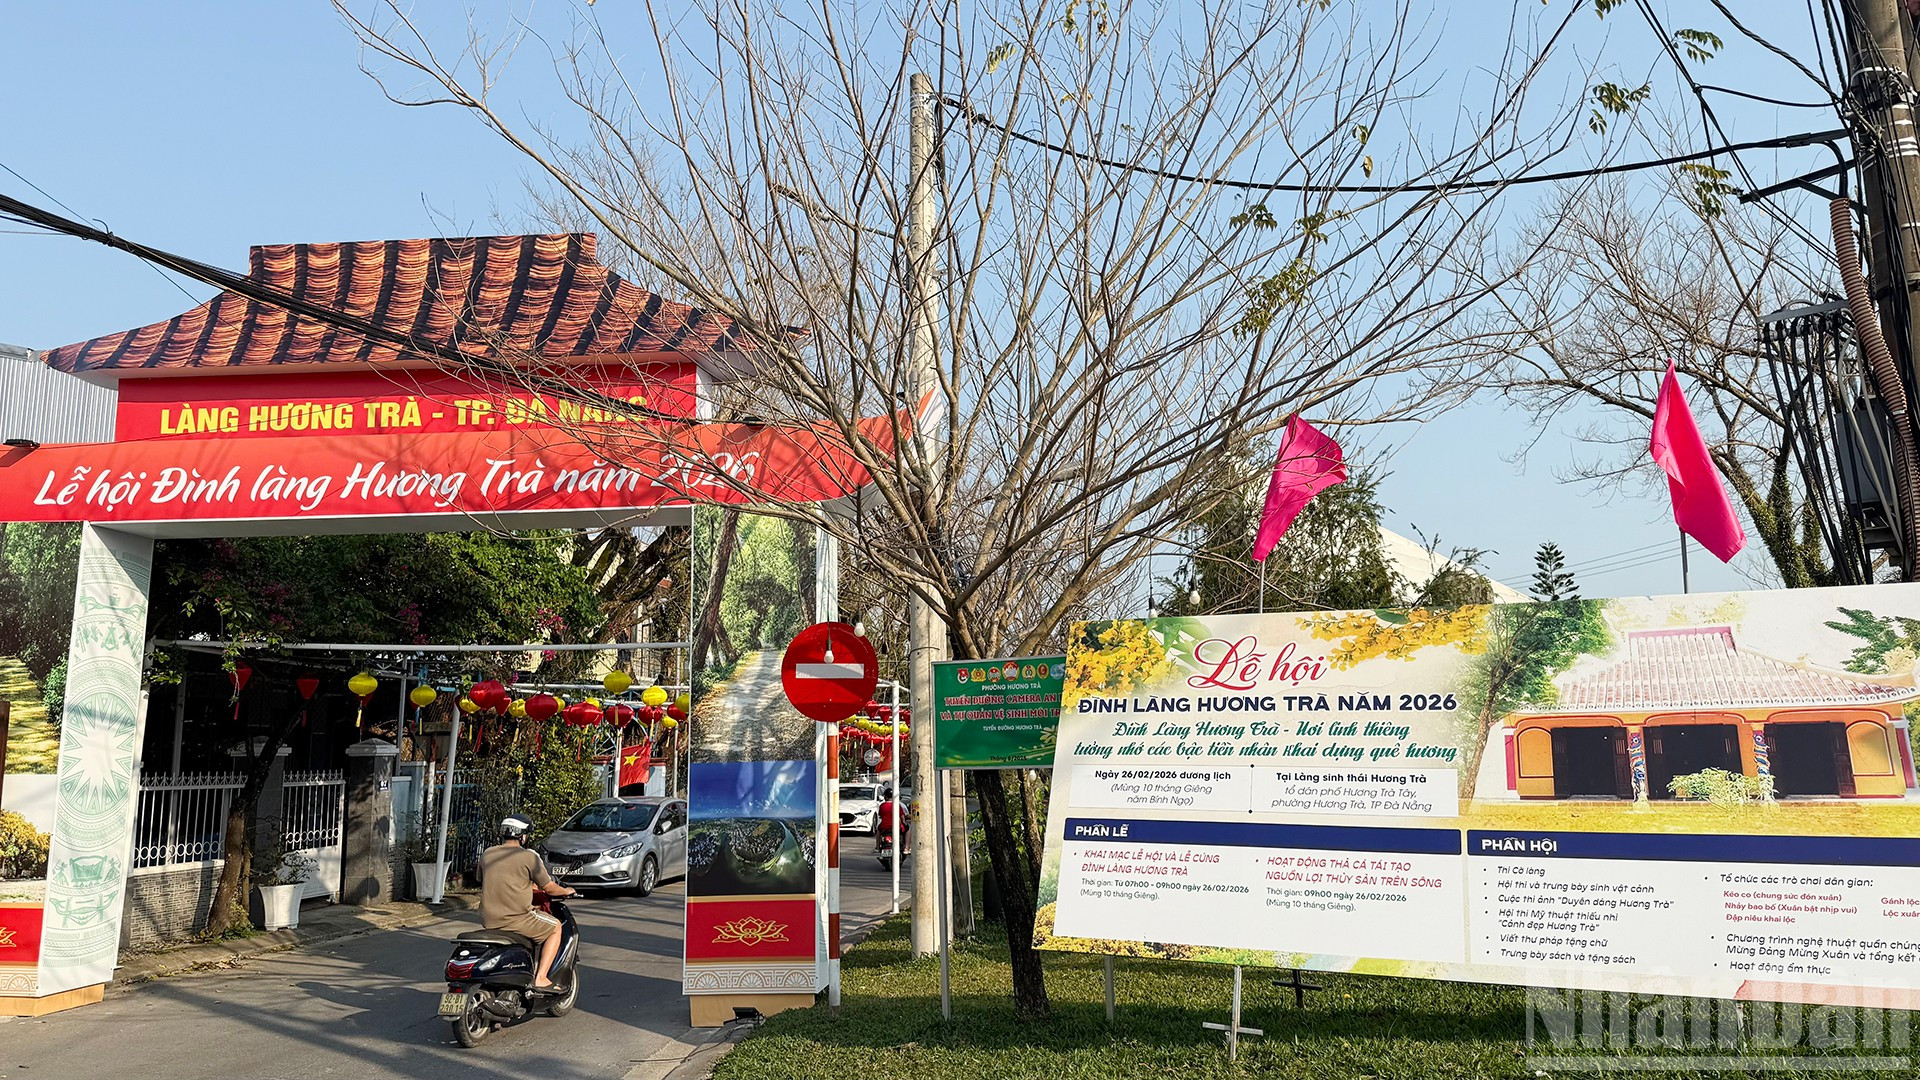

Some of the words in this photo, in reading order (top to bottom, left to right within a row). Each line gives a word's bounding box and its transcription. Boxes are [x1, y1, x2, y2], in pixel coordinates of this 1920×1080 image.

[160, 403, 239, 435] LÀNG
[249, 403, 352, 432] HƯƠNG
[364, 396, 422, 428] TRÀ
[454, 400, 494, 426] TP.
[33, 466, 91, 506] Lễ
[86, 470, 146, 512] hội
[151, 465, 241, 505] Đình
[250, 465, 332, 511] làng
[340, 461, 466, 508] Hương
[480, 458, 546, 496] Trà
[553, 459, 641, 492] năm
[651, 452, 759, 490] 2026
[1188, 636, 1267, 691] Lễ
[1268, 643, 1327, 686] hội
[1006, 694, 1040, 703] CAMERA
[1044, 694, 1056, 702] AN
[1078, 696, 1127, 713] ĐÌNH
[1134, 696, 1190, 712] LÀNG
[1198, 696, 1275, 712] HƯƠNG
[1283, 693, 1330, 711] TRÀ
[1339, 691, 1391, 711] NĂM
[1400, 694, 1457, 711] 2026
[940, 710, 951, 720] VÀ
[994, 708, 1005, 720] VỆ
[1007, 709, 1027, 718] SINH
[1112, 721, 1149, 736] Đình
[1153, 722, 1190, 739] Làng
[1195, 721, 1245, 739] Hương
[1250, 721, 1280, 736] Trà
[1328, 721, 1358, 736] linh
[1363, 721, 1410, 739] thiêng
[1074, 741, 1113, 758] tưởng
[1117, 742, 1144, 755] nhớ
[1148, 742, 1172, 756] các
[1177, 742, 1203, 759] bậc
[1208, 742, 1234, 756] tiền
[1238, 742, 1278, 756] nhân
[1322, 743, 1364, 761] dựng
[1370, 745, 1400, 760] quê
[1405, 743, 1457, 762] hương
[1095, 771, 1118, 779] Ngày
[1122, 771, 1177, 779] 26/02/2026
[1180, 772, 1210, 781] dương
[1214, 771, 1231, 781] lịch
[1277, 772, 1291, 785] Tại
[1295, 772, 1319, 783] Làng
[1323, 773, 1343, 782] sinh
[1347, 774, 1367, 782] thái
[1371, 774, 1406, 784] Hương
[1410, 774, 1426, 783] Trà
[1155, 784, 1181, 793] tháng
[1184, 784, 1212, 794] Giêng
[1285, 785, 1295, 795] tổ
[1298, 787, 1318, 796] dân
[1320, 787, 1342, 797] phố
[1343, 789, 1377, 798] Hương
[1381, 788, 1395, 797] Trà
[1150, 796, 1168, 804] Bính
[1271, 799, 1311, 808] phường
[1313, 800, 1347, 810] Hương
[1371, 801, 1382, 809] TP
[1384, 801, 1399, 810] Đà
[1402, 800, 1432, 812] Nẵng
[1075, 824, 1109, 837] PHẦN
[1113, 824, 1129, 837] LỄ
[1482, 837, 1525, 851] PHẦN
[1531, 838, 1557, 855] HỘI
[1084, 850, 1107, 858] KHAI
[1109, 851, 1130, 861] MẠC
[1132, 849, 1143, 860] LỄ
[1145, 851, 1162, 863] HỘI
[1165, 851, 1177, 861] VÀ
[1179, 849, 1190, 862] LỄ
[1193, 852, 1220, 863] CÚNG
[1082, 863, 1105, 872] ĐÌNH
[1107, 864, 1132, 873] LÀNG
[1171, 867, 1188, 876] TRÀ
[1268, 856, 1295, 868] HOẠT
[1297, 858, 1326, 868] ĐỘNG
[1330, 858, 1349, 868] THẢ
[1353, 859, 1366, 869] CÁ
[1371, 860, 1388, 870] TÁI
[1391, 862, 1411, 872] TẠO
[1498, 866, 1510, 874] Thi
[1526, 867, 1545, 877] làng
[1306, 873, 1322, 883] LỢI
[1355, 874, 1377, 885] SẢN
[1381, 875, 1407, 886] TRÊN
[1411, 878, 1442, 888] SÔNG
[1498, 881, 1512, 890] Hội
[1515, 881, 1527, 889] thi
[1543, 882, 1568, 892] trưng
[1571, 883, 1588, 892] bày
[1590, 884, 1609, 892] sinh
[1613, 884, 1628, 893] vật
[1631, 884, 1654, 893] cảnh
[1720, 873, 1732, 882] Tổ
[1735, 874, 1758, 883] chức
[1761, 875, 1778, 884] các
[1782, 876, 1797, 884] trò
[1800, 877, 1822, 885] chơi
[1824, 877, 1844, 885] dân
[1847, 878, 1873, 888] gian:
[1267, 887, 1282, 895] Thời
[1304, 890, 1332, 898] 09h00
[1334, 891, 1353, 900] ngày
[1356, 893, 1406, 901] 26/02/2026
[1498, 894, 1520, 904] Cuộc
[1523, 895, 1535, 903] thi
[1538, 894, 1555, 904] ảnh
[1619, 899, 1650, 909] Hương
[1499, 909, 1513, 918] Hội
[1531, 910, 1546, 919] Mỹ
[1548, 910, 1574, 920] thuật
[1577, 912, 1600, 921] thiếu
[1603, 913, 1618, 921] nhi
[1730, 961, 1755, 970] Hoạt
[1758, 963, 1783, 974] động
[1807, 965, 1831, 975] thực
